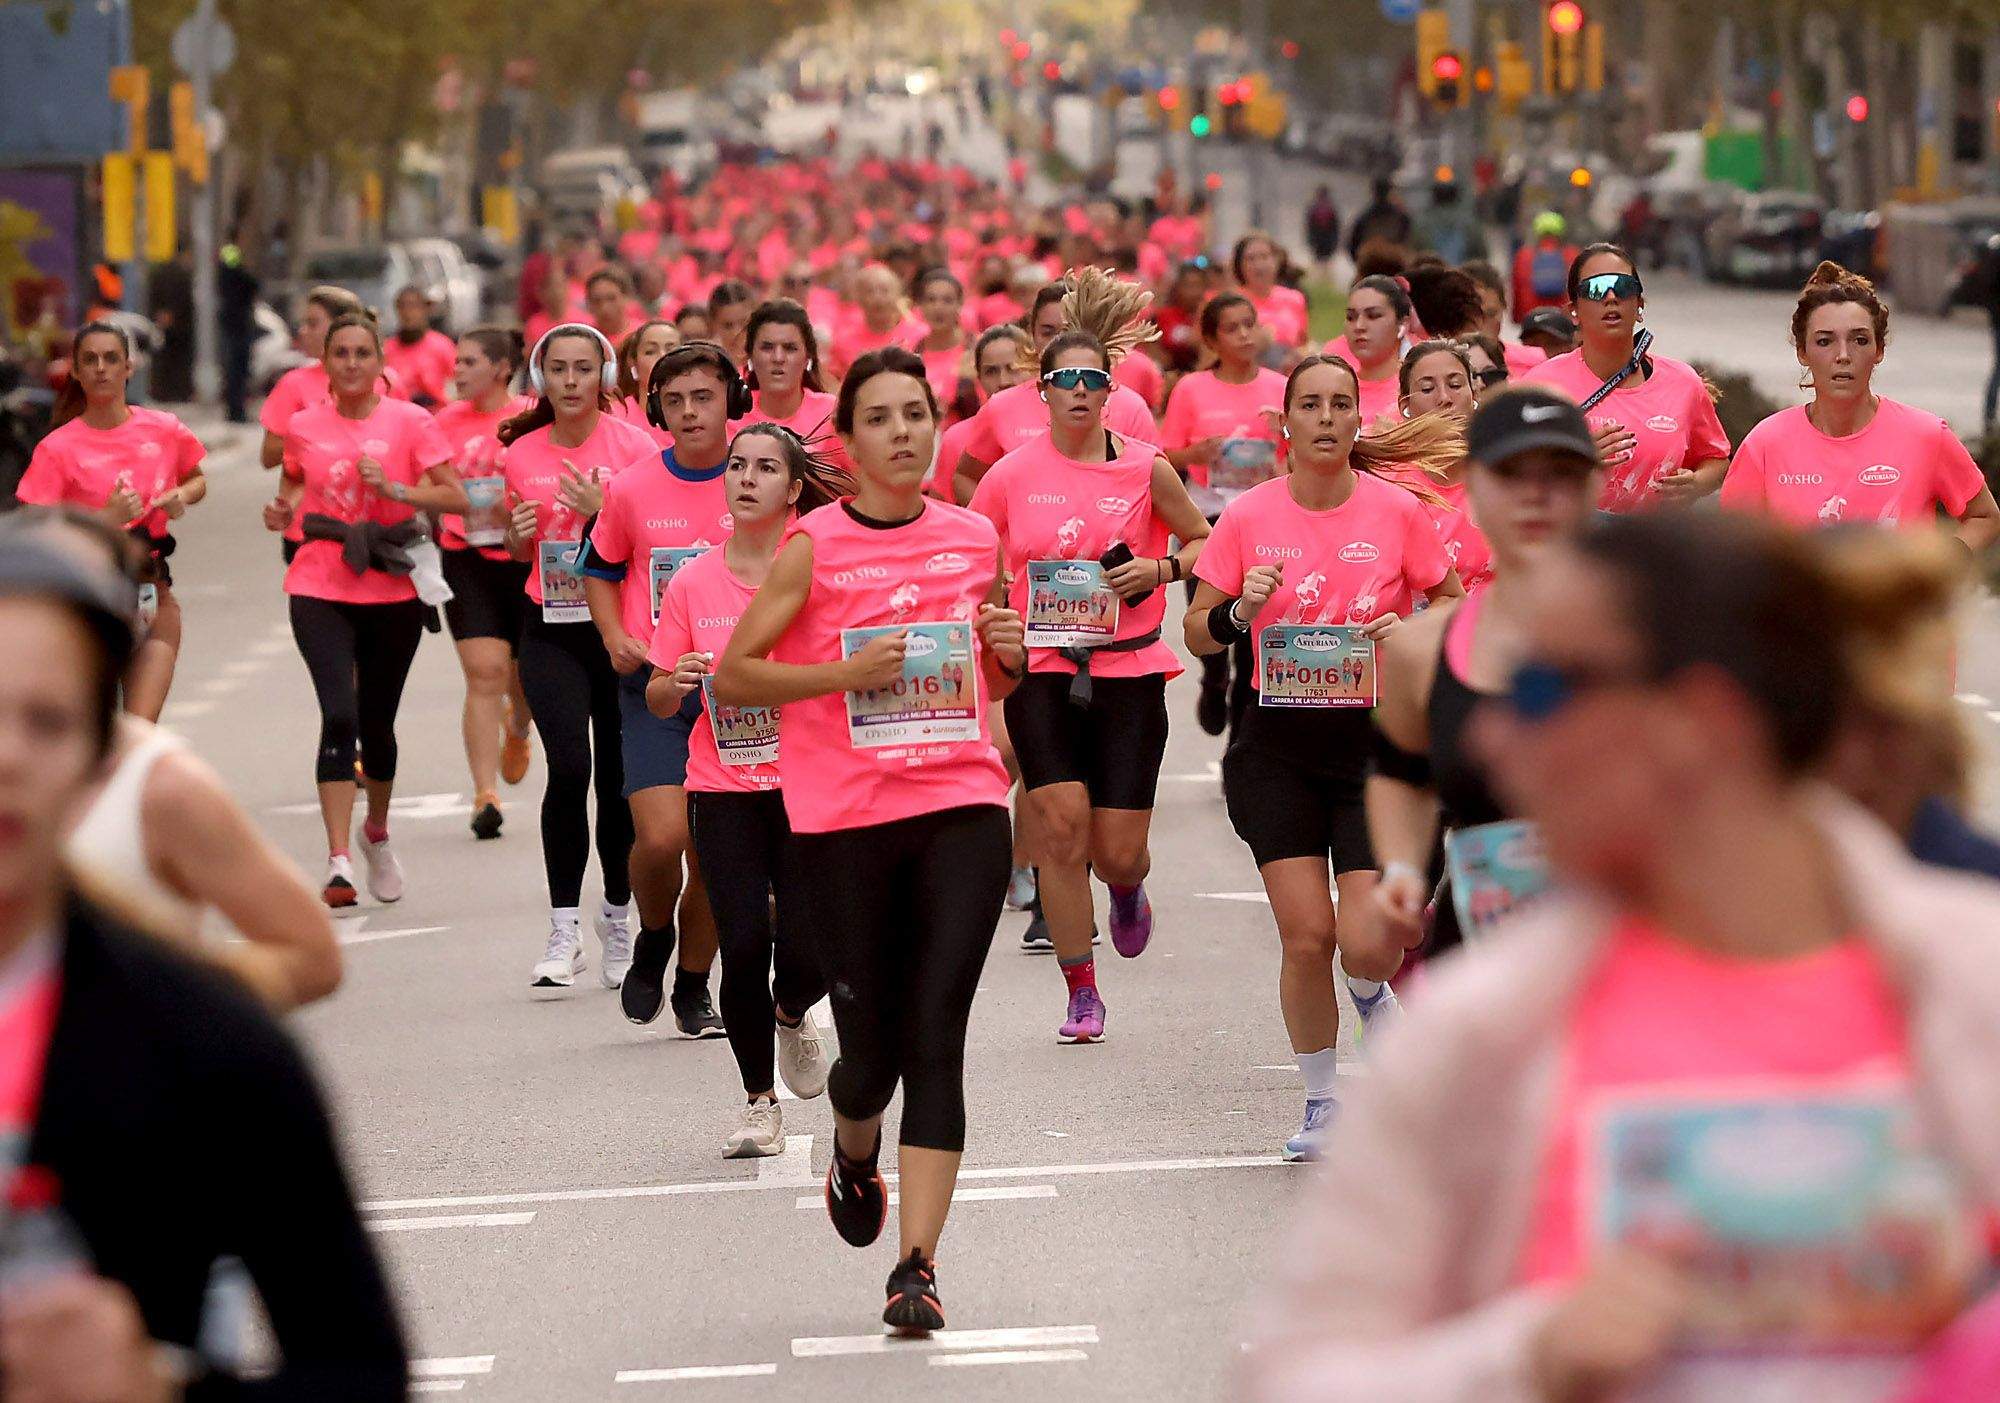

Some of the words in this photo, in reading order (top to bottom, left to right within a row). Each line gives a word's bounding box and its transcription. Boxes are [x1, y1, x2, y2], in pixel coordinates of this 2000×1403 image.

[1779, 473, 1822, 485] OYSHO
[1027, 494, 1066, 505] OYSHO
[646, 518, 688, 529] OYSHO
[1255, 544, 1302, 558] OYSHO
[833, 566, 888, 584] OYSHO
[1057, 599, 1089, 613] 016
[698, 616, 739, 629] OYSHO
[1296, 637, 1339, 647] ASTURIANA
[1297, 667, 1340, 684] 016
[891, 675, 939, 696] 016
[743, 705, 781, 727] 016
[755, 727, 775, 737] 9750
[725, 740, 748, 748] CARRERA
[729, 749, 762, 759] OYSHO
